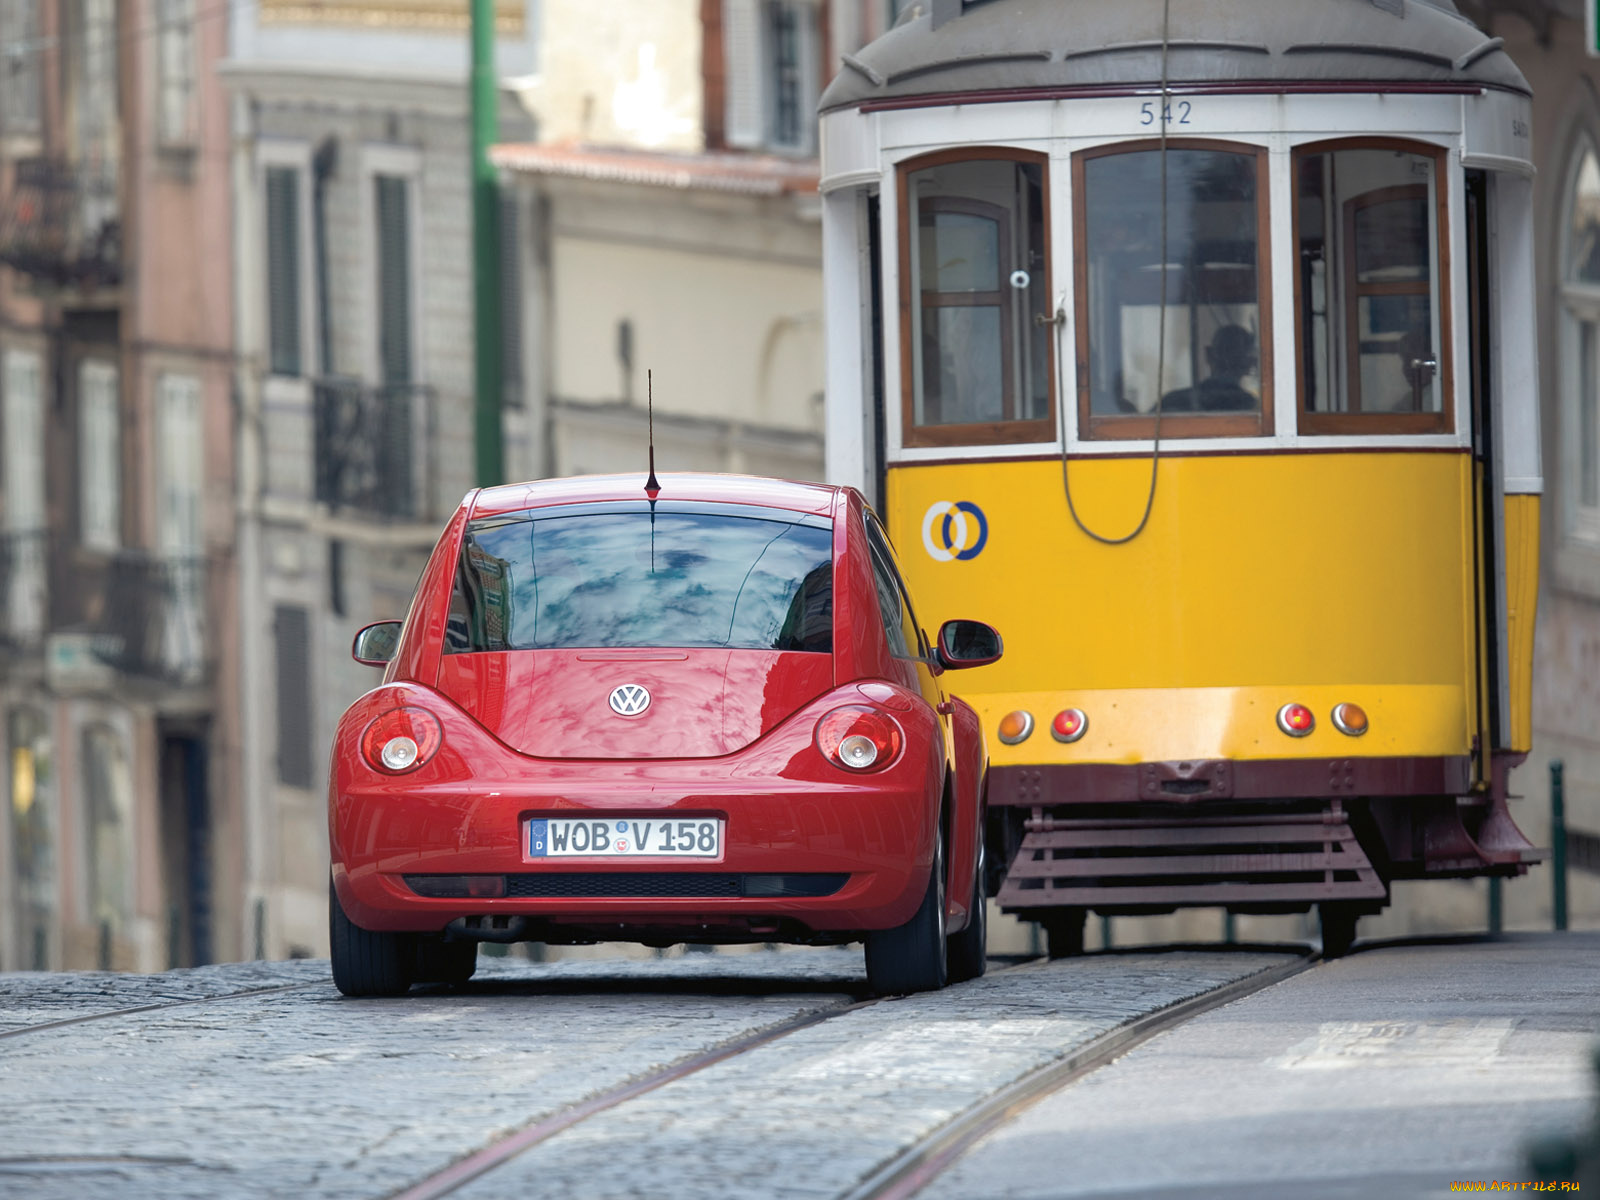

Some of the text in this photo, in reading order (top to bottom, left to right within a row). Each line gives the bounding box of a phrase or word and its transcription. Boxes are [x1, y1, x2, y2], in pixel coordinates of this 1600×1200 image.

[1140, 101, 1191, 125] 542
[609, 683, 651, 716] VW
[535, 841, 543, 850] D
[551, 822, 715, 851] WOB V 158
